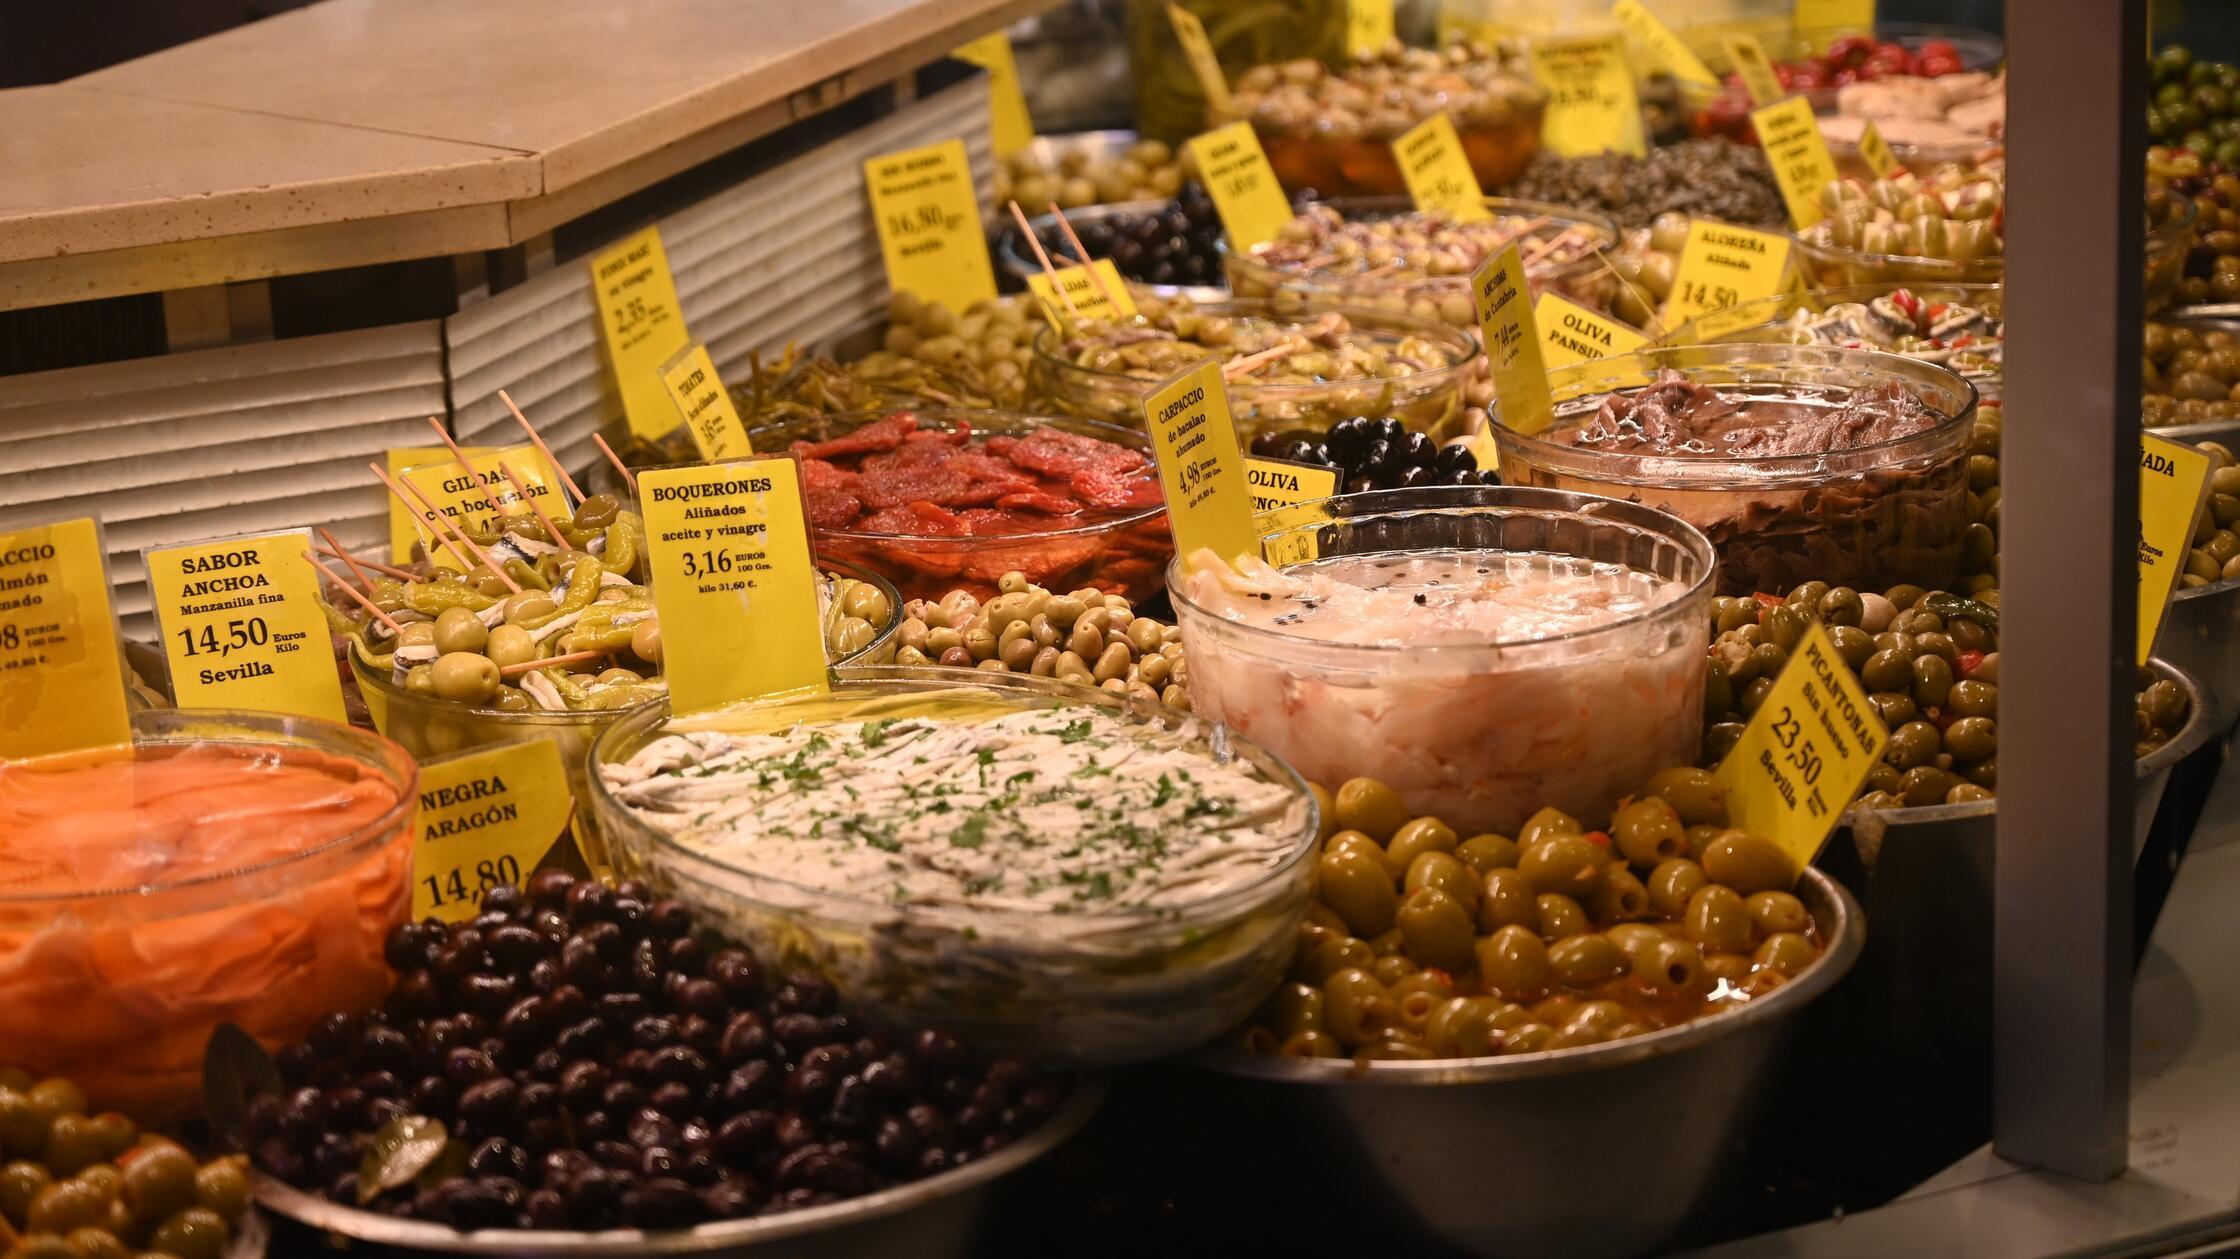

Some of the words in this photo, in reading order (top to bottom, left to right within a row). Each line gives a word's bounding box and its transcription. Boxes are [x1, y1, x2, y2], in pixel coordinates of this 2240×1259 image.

[1563, 313, 1612, 346] OLIVA
[1159, 387, 1205, 424] CARPACCIO
[1168, 428, 1177, 443] de
[1176, 413, 1206, 437] bacalao
[1176, 433, 1206, 458] ahumado
[653, 477, 772, 502] BOQUERONES
[1179, 460, 1200, 495] 4,98
[1248, 470, 1299, 491] OLIVA
[684, 504, 746, 519] Aliñados
[662, 529, 702, 541] aceite
[705, 528, 713, 540] y
[717, 522, 767, 537] vinagre
[2141, 541, 2163, 557] Euros
[181, 550, 261, 574] SABOR
[682, 549, 732, 580] 3,16
[735, 551, 766, 562] EUROS
[737, 564, 753, 573] 100
[181, 573, 269, 598] ANCHOA
[698, 583, 717, 593] kilo
[718, 581, 745, 592] 31,60
[180, 598, 254, 616] Manzanilla
[258, 592, 285, 605] fina
[178, 617, 268, 658] 14,50
[273, 631, 306, 643] Euros
[275, 643, 300, 654] Kilo
[200, 661, 274, 685] Sevilla
[1806, 641, 1877, 756] PICANTONAS
[1771, 705, 1822, 785] 23,50
[1760, 748, 1798, 811] Sevilla
[420, 776, 508, 811] NEGRA
[425, 803, 518, 841] ARAGÓN
[422, 855, 520, 908] 14,80
